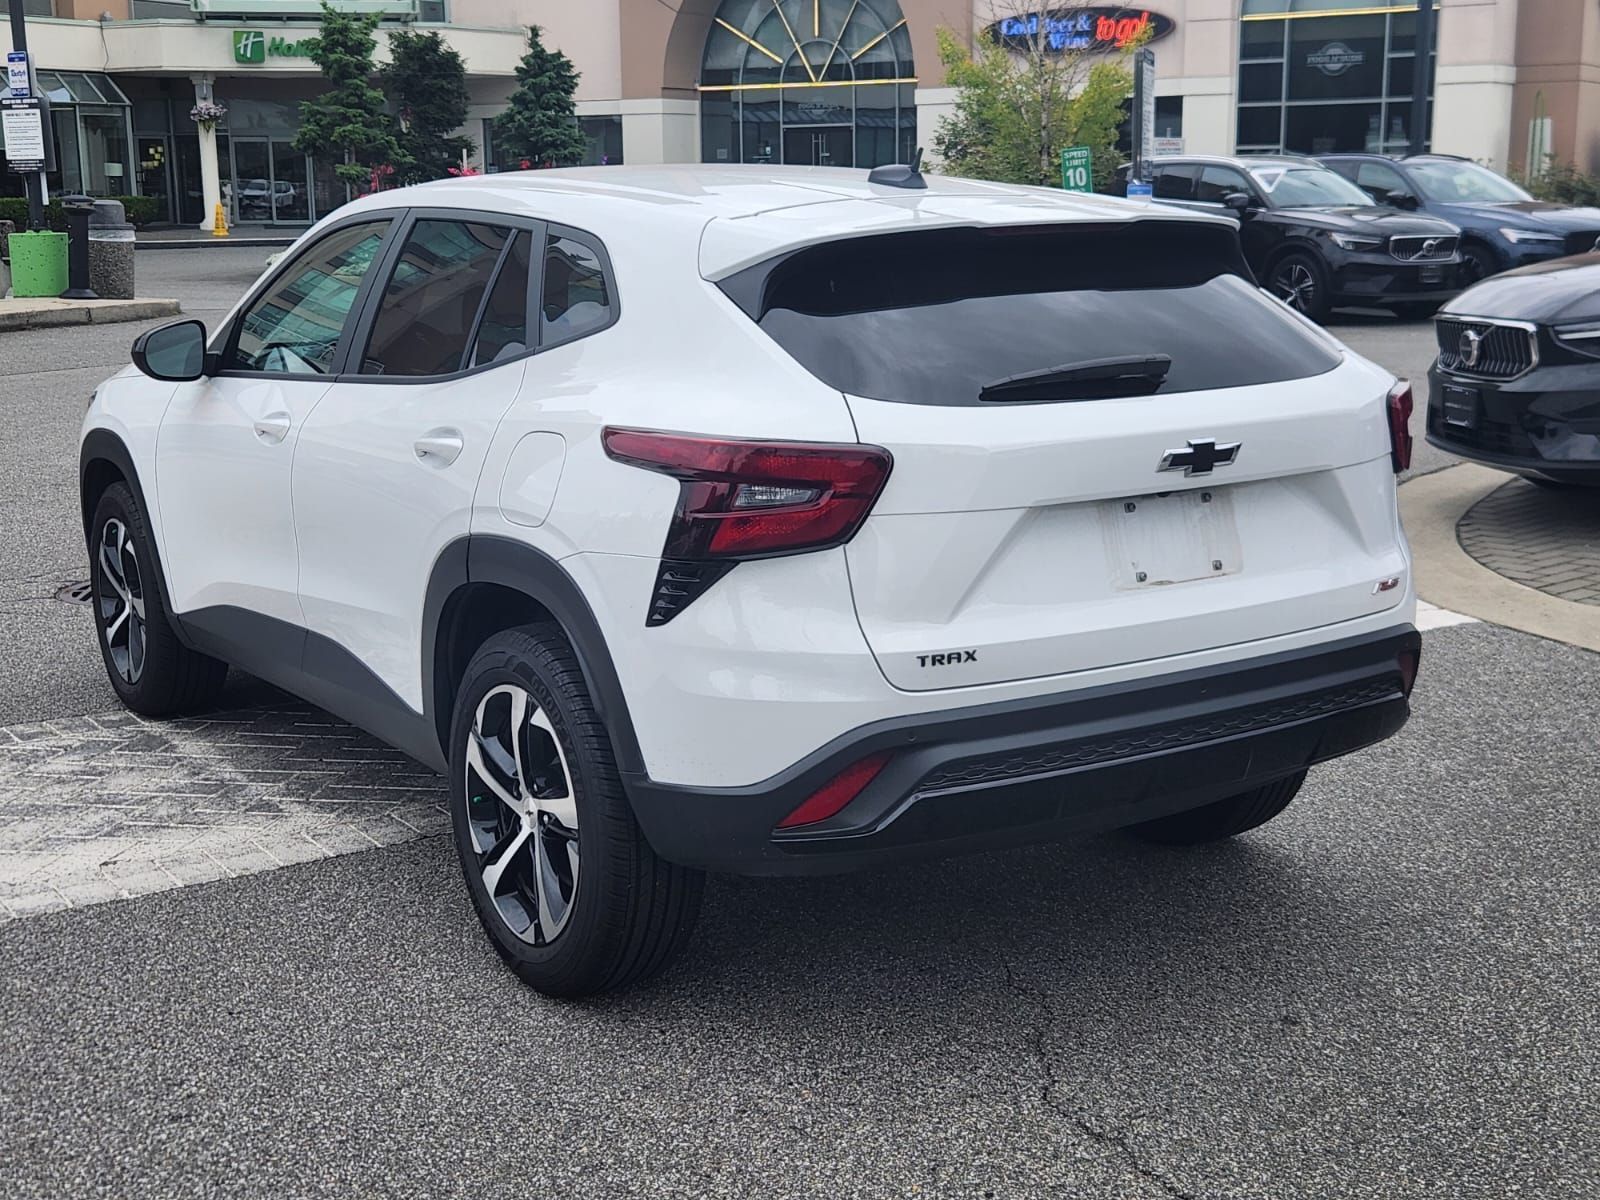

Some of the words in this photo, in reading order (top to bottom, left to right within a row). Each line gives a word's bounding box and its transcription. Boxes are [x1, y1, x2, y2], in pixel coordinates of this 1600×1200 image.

[1096, 16, 1114, 41] to
[1063, 150, 1088, 159] SPEED
[1065, 158, 1087, 167] LIMIT
[1066, 167, 1087, 187] 10
[915, 649, 978, 668] TRAX
